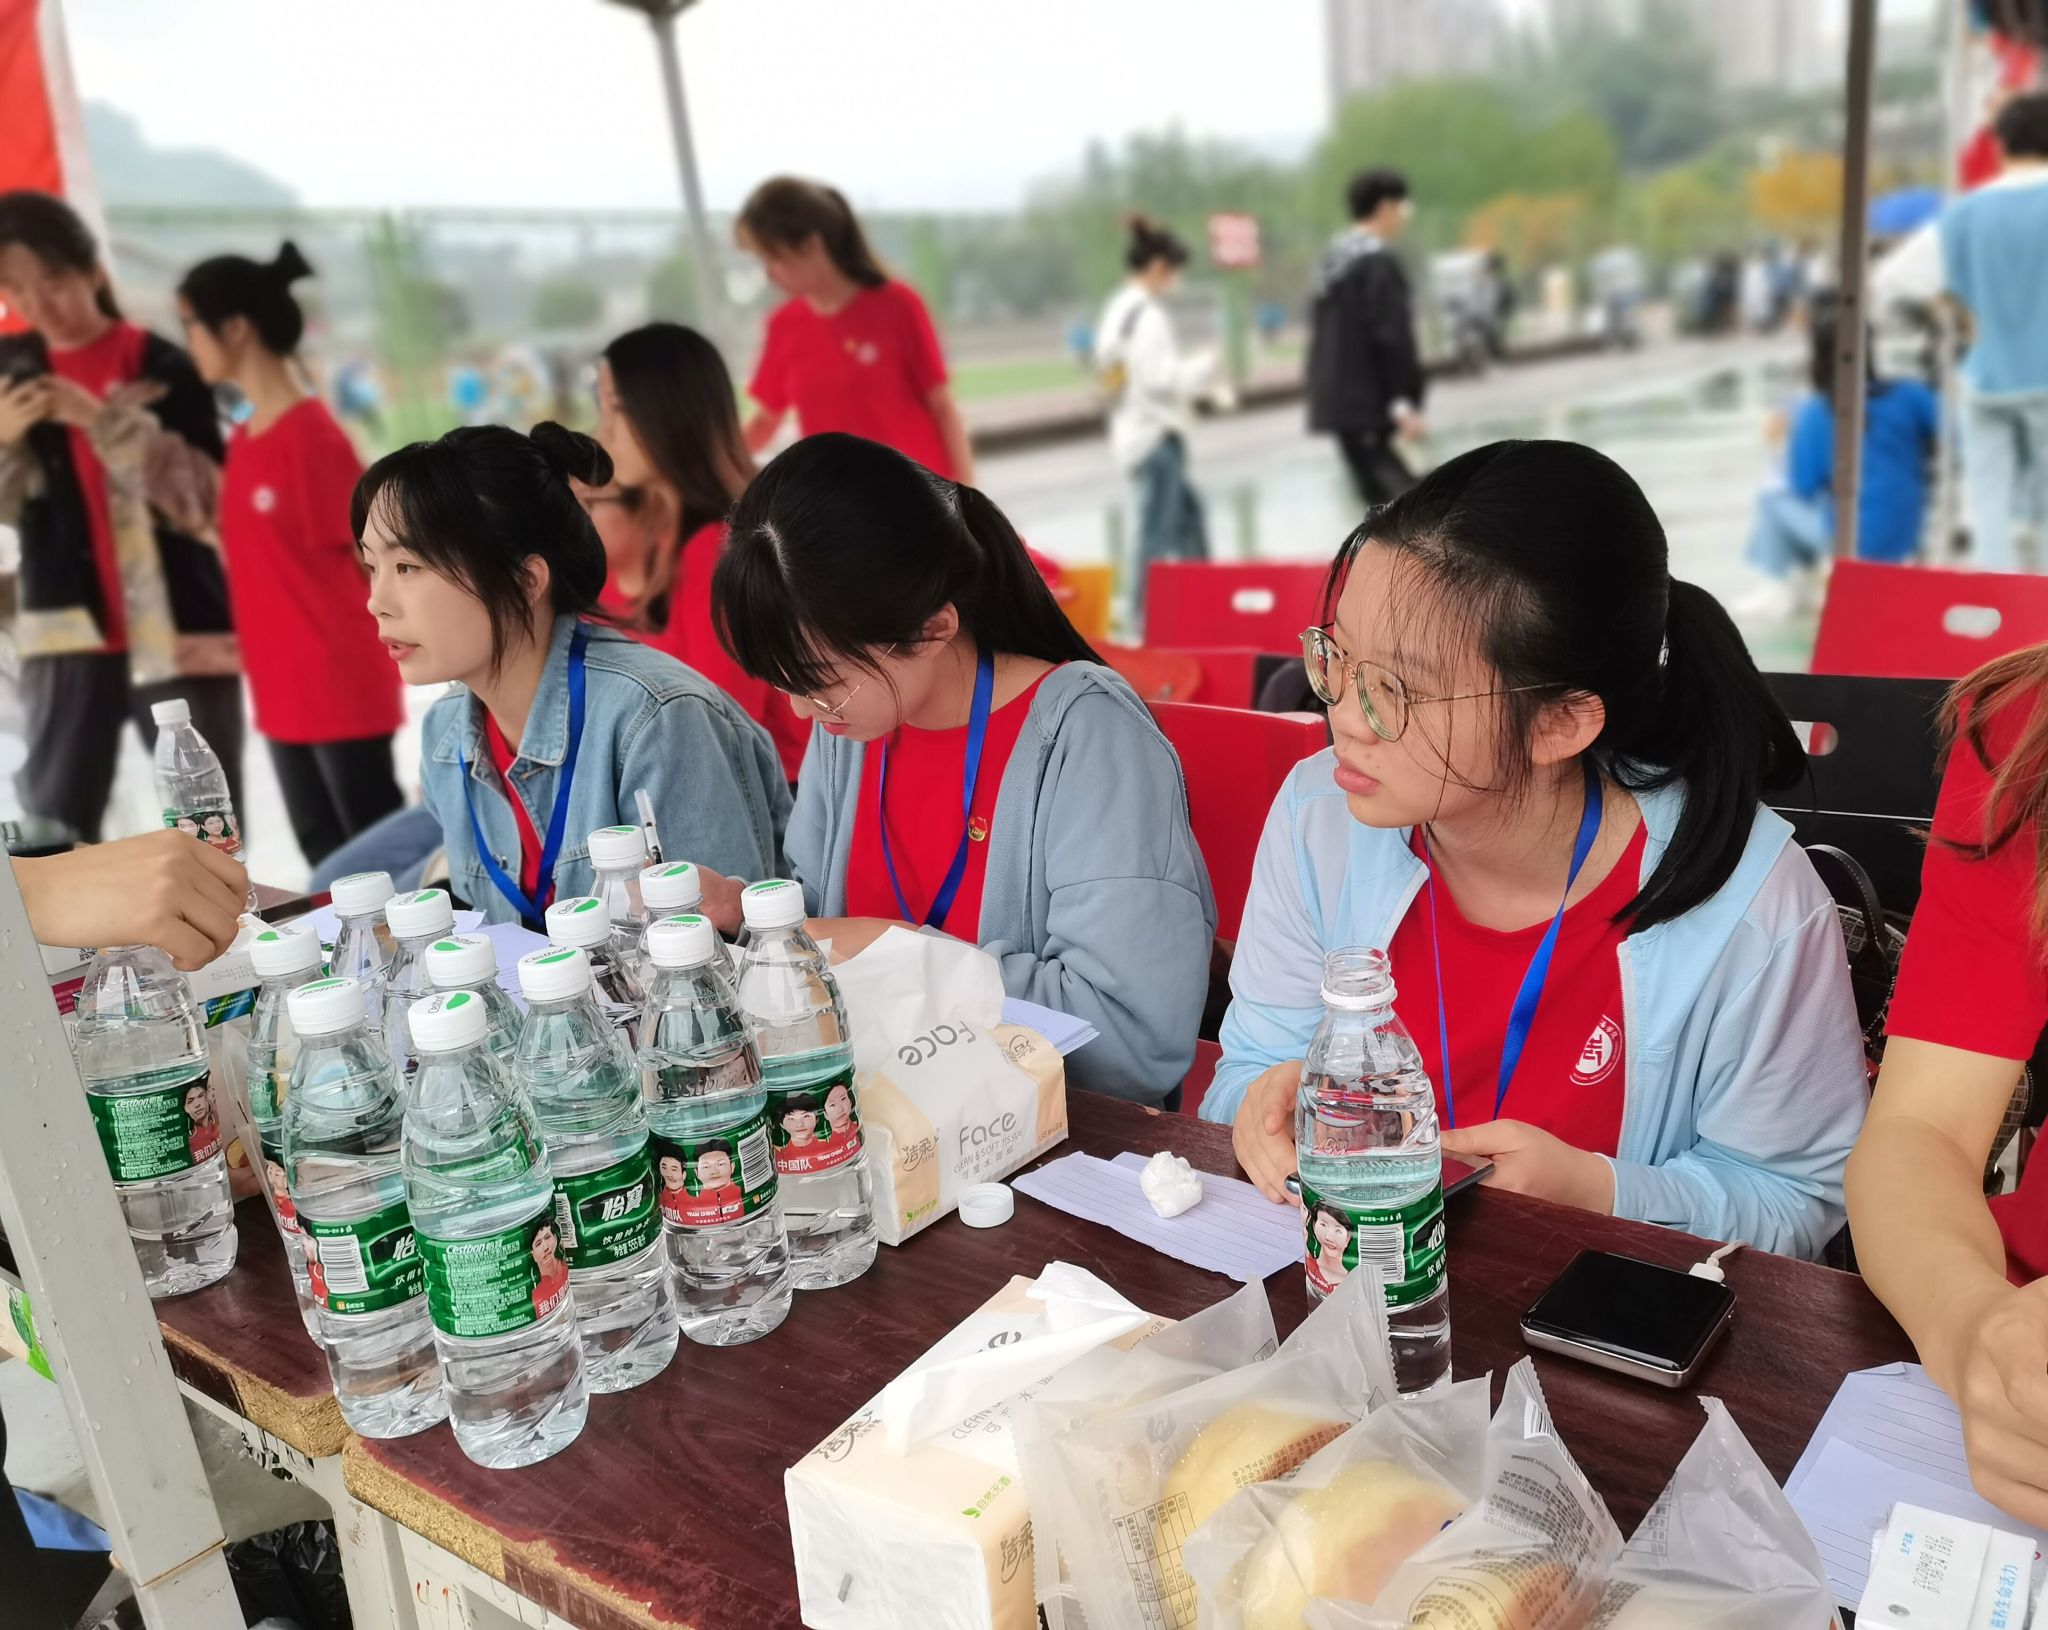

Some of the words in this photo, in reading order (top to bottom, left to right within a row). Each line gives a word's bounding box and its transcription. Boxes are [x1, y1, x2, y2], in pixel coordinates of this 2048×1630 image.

[958, 1112, 1017, 1156] Face
[777, 1157, 813, 1172] 中国队
